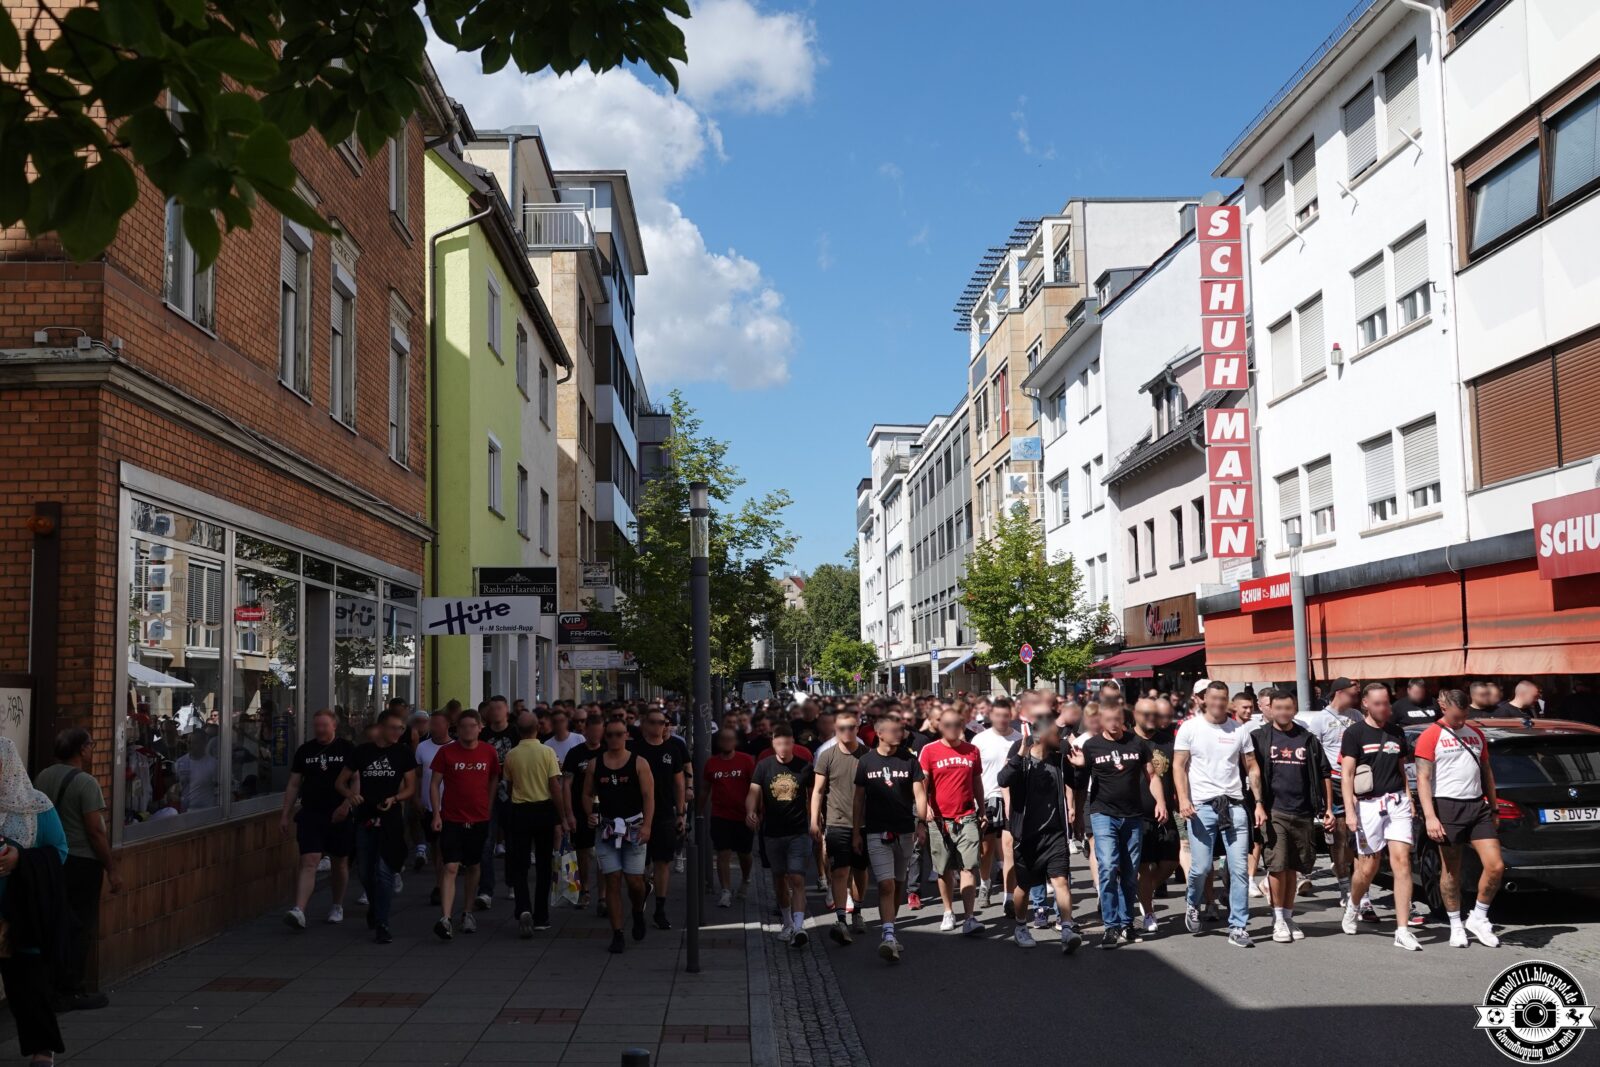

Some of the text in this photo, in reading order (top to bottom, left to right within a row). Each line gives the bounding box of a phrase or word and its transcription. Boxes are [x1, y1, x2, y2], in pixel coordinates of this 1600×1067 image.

[1207, 209, 1240, 385] SCHUH
[1211, 412, 1248, 554] MANN
[1540, 512, 1600, 557] SCHU
[1241, 582, 1290, 604] SCHUH MANN
[428, 600, 511, 635] Hüte
[1553, 808, 1598, 821] S DV 57
